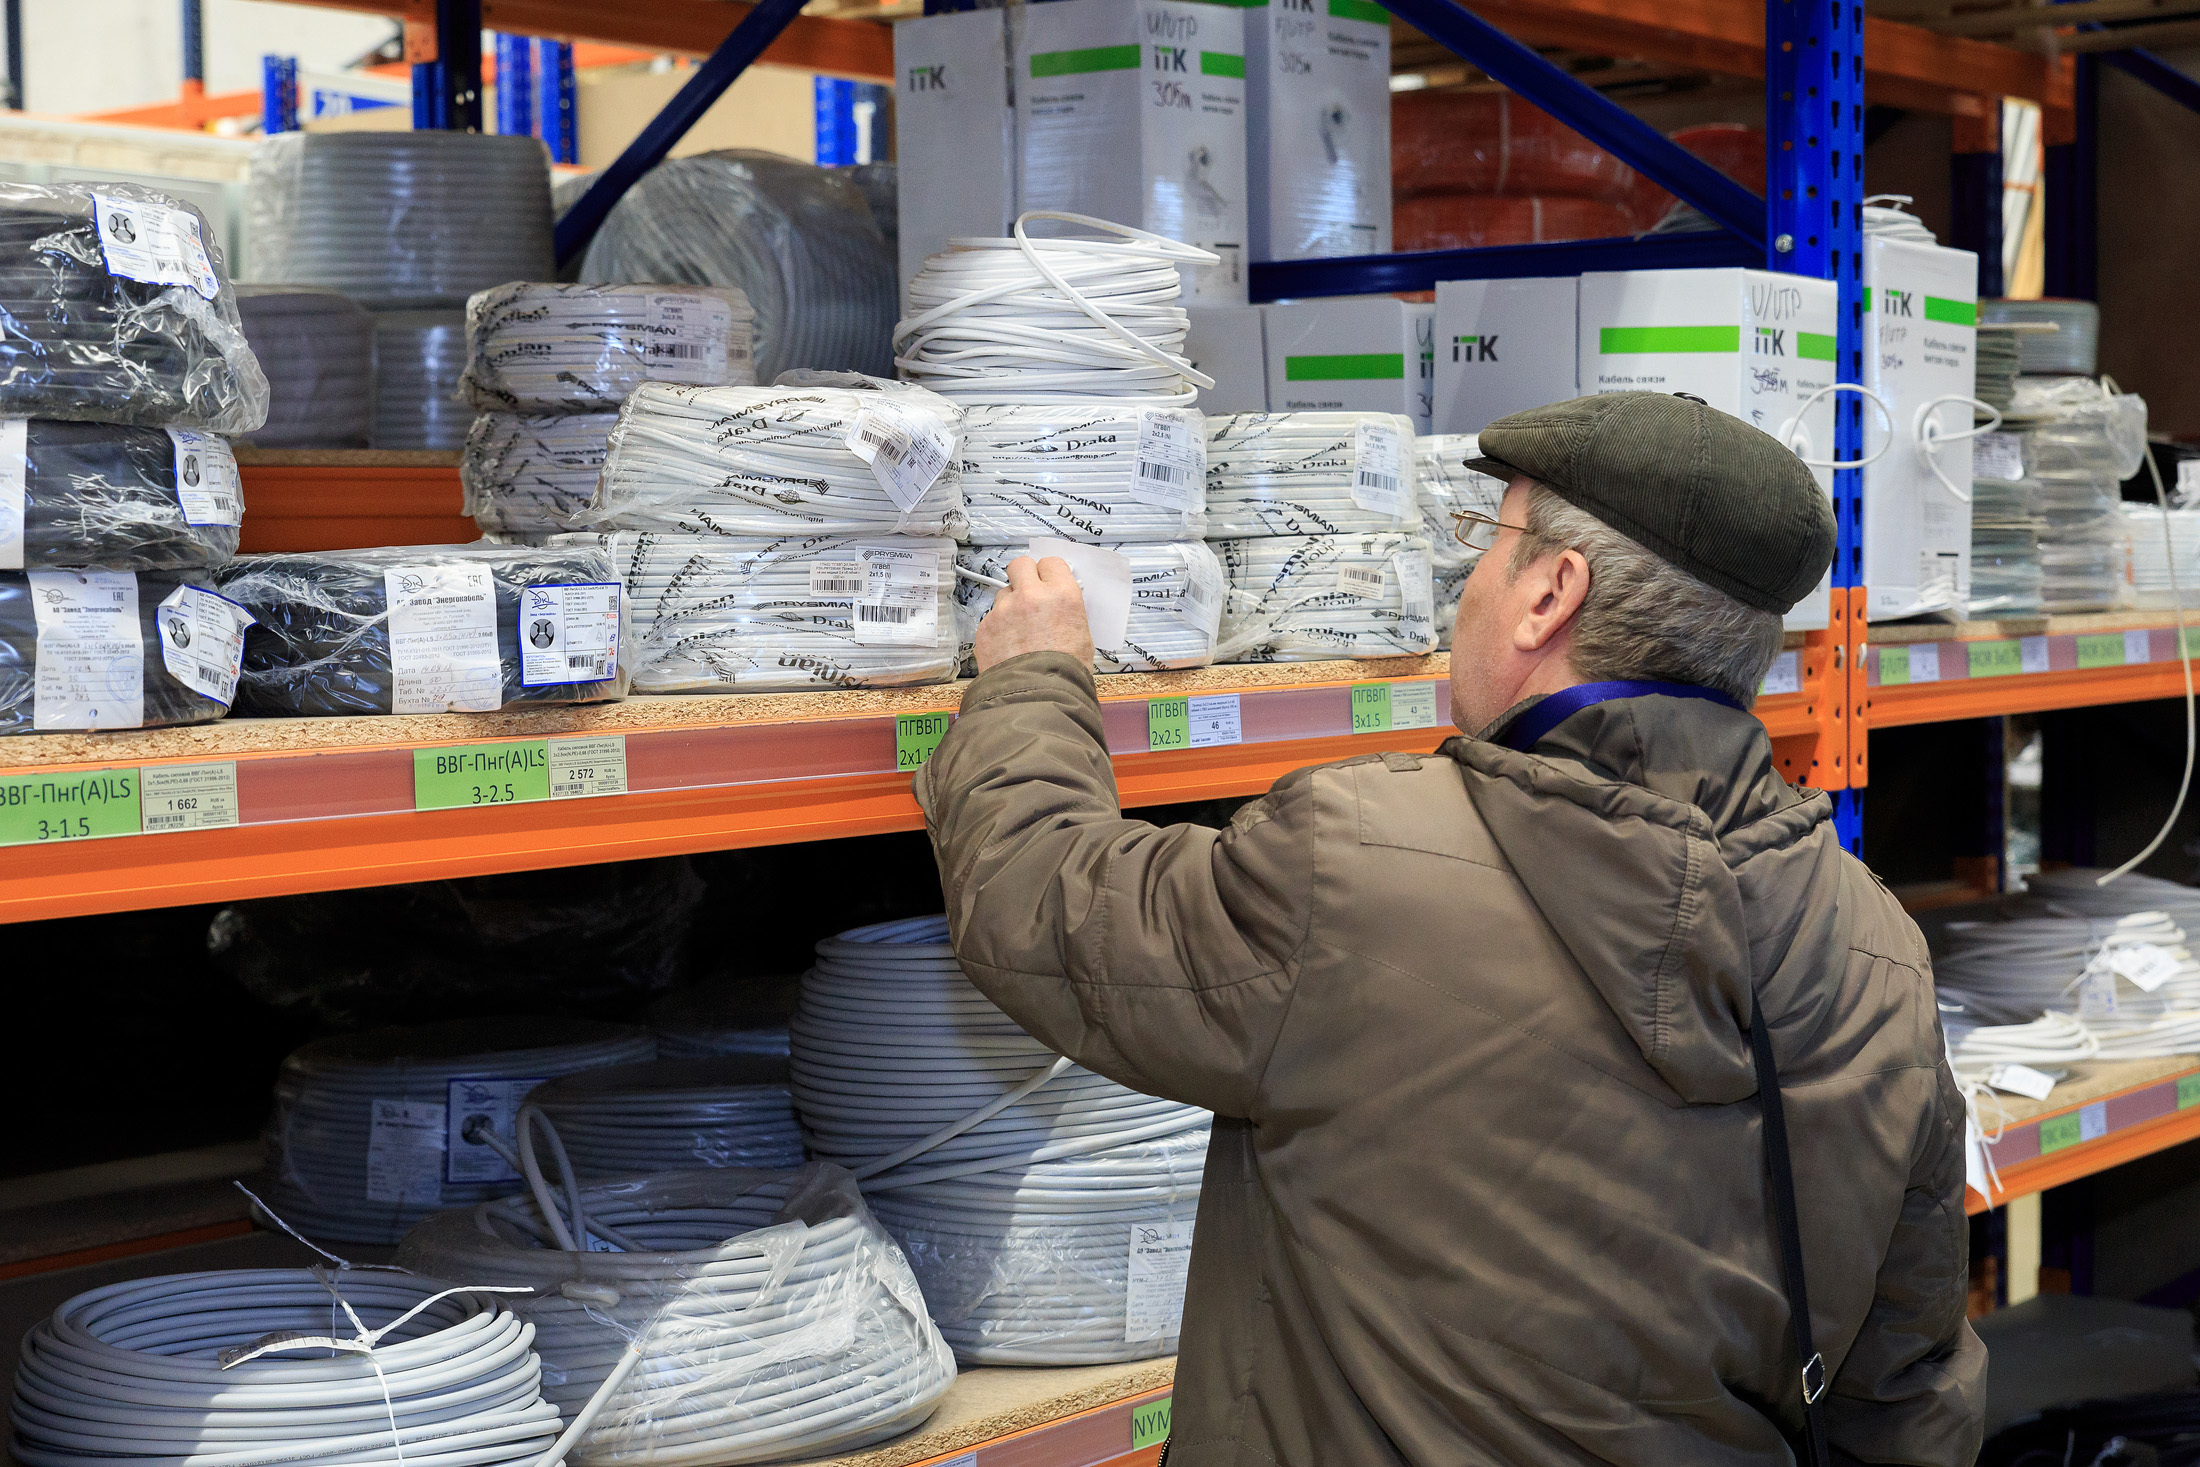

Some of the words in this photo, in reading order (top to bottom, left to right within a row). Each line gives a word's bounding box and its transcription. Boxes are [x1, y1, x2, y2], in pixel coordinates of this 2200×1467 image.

[1599, 374, 1634, 385] Кабель
[1636, 375, 1666, 384] связи
[1066, 434, 1117, 451] Draka
[1057, 503, 1104, 537] Draka
[873, 550, 913, 560] PRYSMIAN
[813, 615, 855, 631] Drak
[397, 667, 416, 675] Дата
[397, 678, 422, 686] Длина
[1353, 688, 1386, 704] ПГВВП
[1151, 701, 1187, 719] ПГВВП
[899, 717, 942, 737] ПГВВП
[1211, 720, 1220, 730] 46
[1354, 712, 1381, 729] 3x1.5
[1152, 728, 1182, 746] 2x2.5
[436, 747, 545, 775] ВВГ-Пнг(А)LS
[569, 769, 575, 780] 2
[577, 768, 594, 779] 572
[472, 783, 515, 805] 3-2.5
[177, 797, 198, 810] 662
[38, 817, 90, 841] 3-1.5
